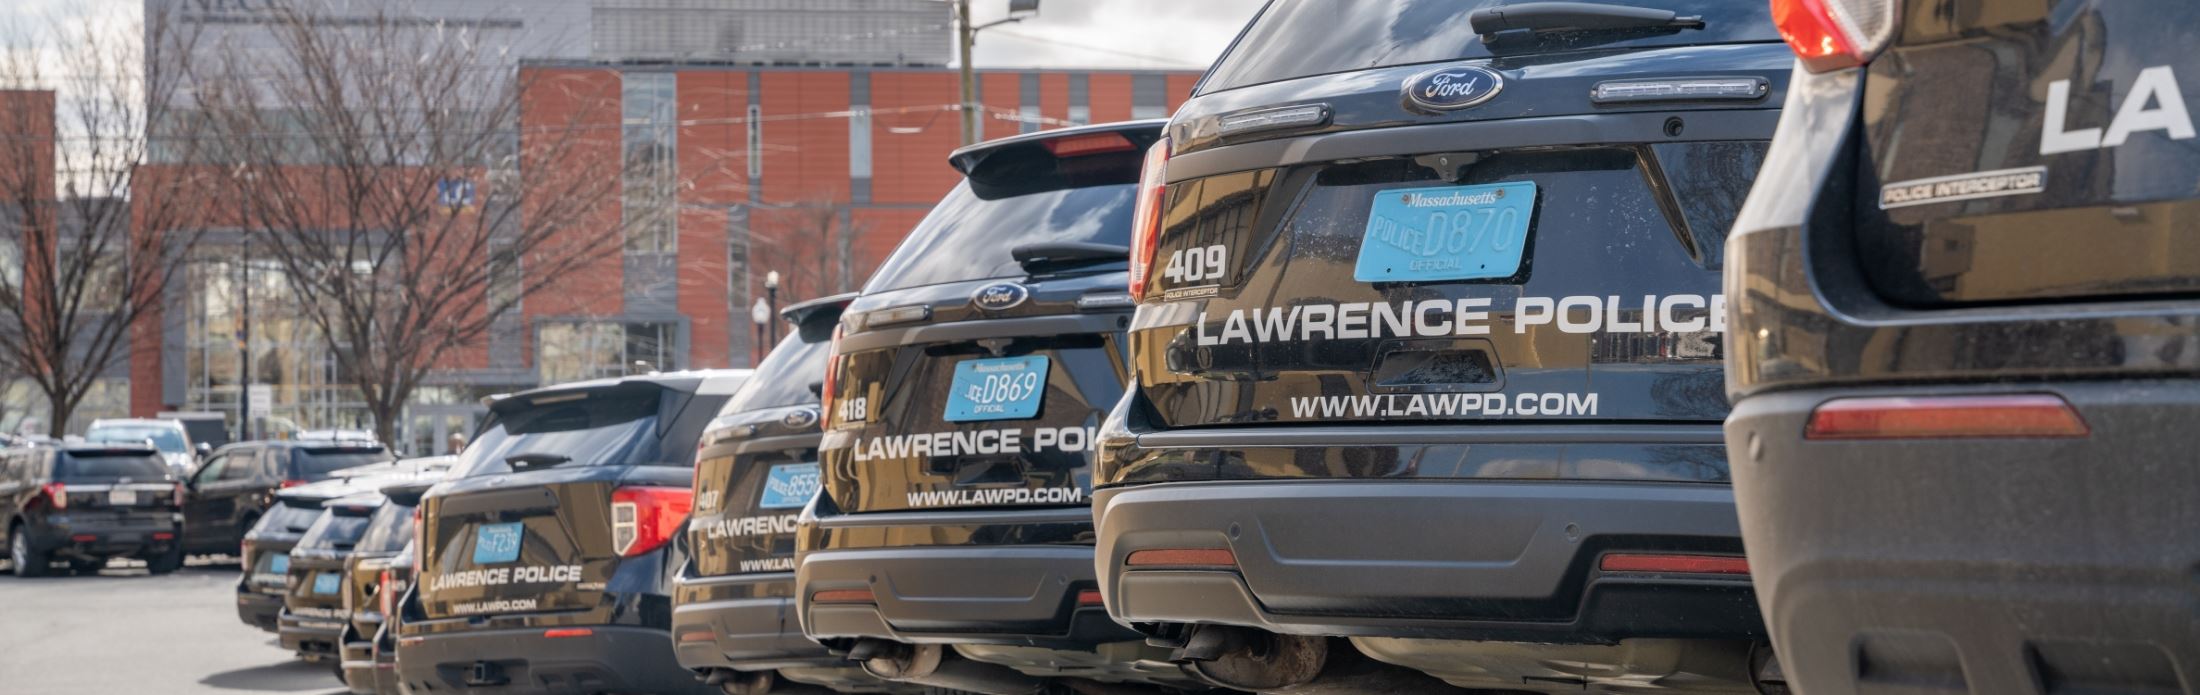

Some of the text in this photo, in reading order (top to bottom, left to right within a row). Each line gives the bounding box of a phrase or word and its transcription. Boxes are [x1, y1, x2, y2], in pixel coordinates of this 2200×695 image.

[1425, 73, 1478, 98] Ford
[1407, 190, 1497, 208] Massachusetts
[1884, 173, 2040, 202] POLICE INTERCEPTOR
[1373, 207, 1518, 257] POLICE D870
[1164, 244, 1226, 283] 409
[1408, 257, 1462, 272] OFFICIAL
[983, 286, 1013, 304] Ford
[1197, 298, 1492, 346] LAWRENCE
[981, 371, 1038, 404] D869
[838, 397, 867, 421] 418
[974, 404, 1005, 414] OFFICIAL
[1291, 392, 1598, 418] WWW.LAWPD.COM
[854, 428, 1022, 462] LAWRENCE
[907, 487, 1082, 507] WWW.LAWPD.COM
[430, 568, 509, 592] LAWRENCE
[513, 565, 583, 584] POLICE
